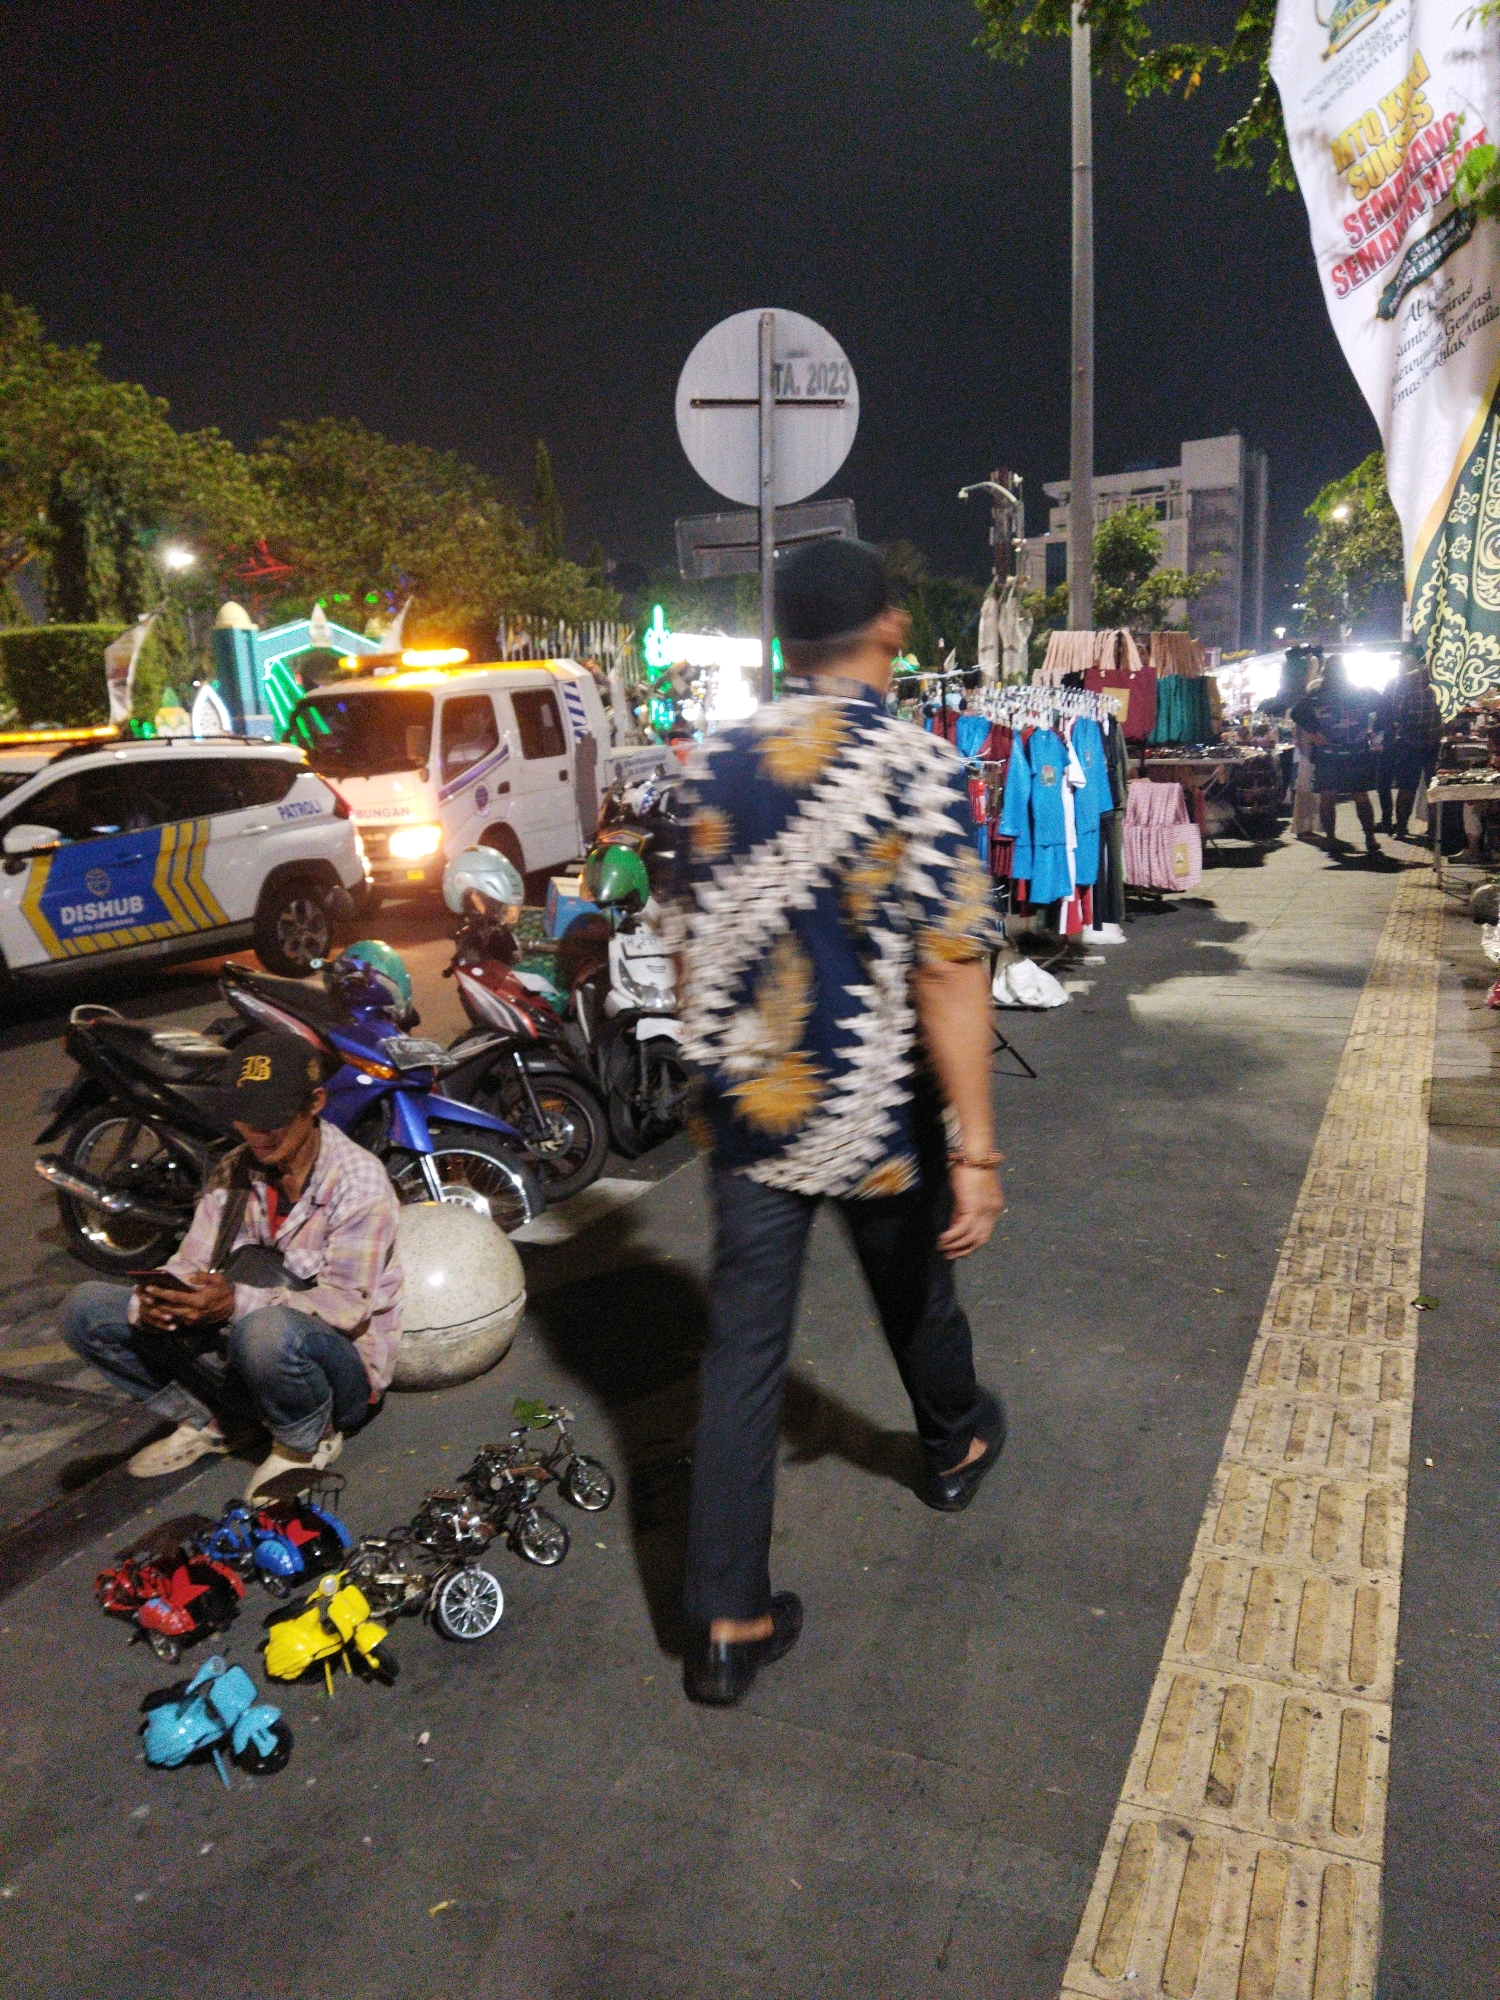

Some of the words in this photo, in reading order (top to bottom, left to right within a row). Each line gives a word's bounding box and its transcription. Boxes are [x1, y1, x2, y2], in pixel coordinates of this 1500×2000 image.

[1330, 108, 1387, 175] MTQ
[806, 361, 850, 396] 2023
[276, 799, 323, 821] PATROLI
[352, 806, 410, 819] BUNGAN
[60, 895, 145, 926] DISHUB
[235, 1054, 272, 1088] B
